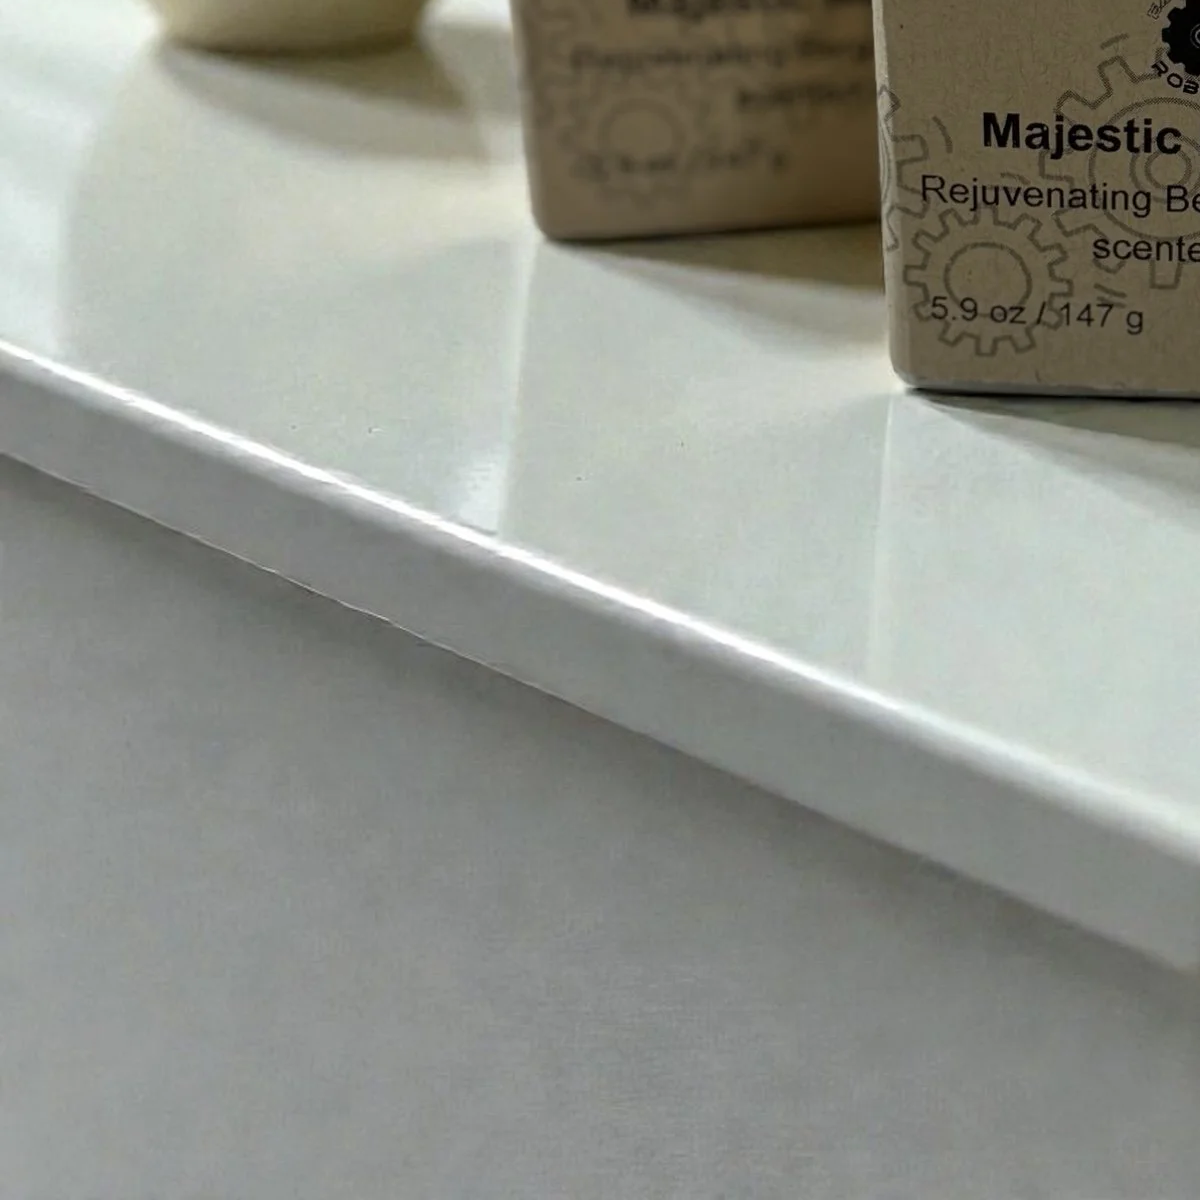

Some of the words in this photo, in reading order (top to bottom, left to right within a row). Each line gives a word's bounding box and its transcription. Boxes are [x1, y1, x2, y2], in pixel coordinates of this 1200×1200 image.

[982, 111, 1183, 161] Majestic
[921, 174, 1152, 219] Rejuvenating
[930, 295, 980, 323] 5.9
[989, 305, 1027, 326] oz
[1035, 301, 1047, 326] /
[1060, 302, 1115, 328] 147
[1126, 311, 1144, 335] g
